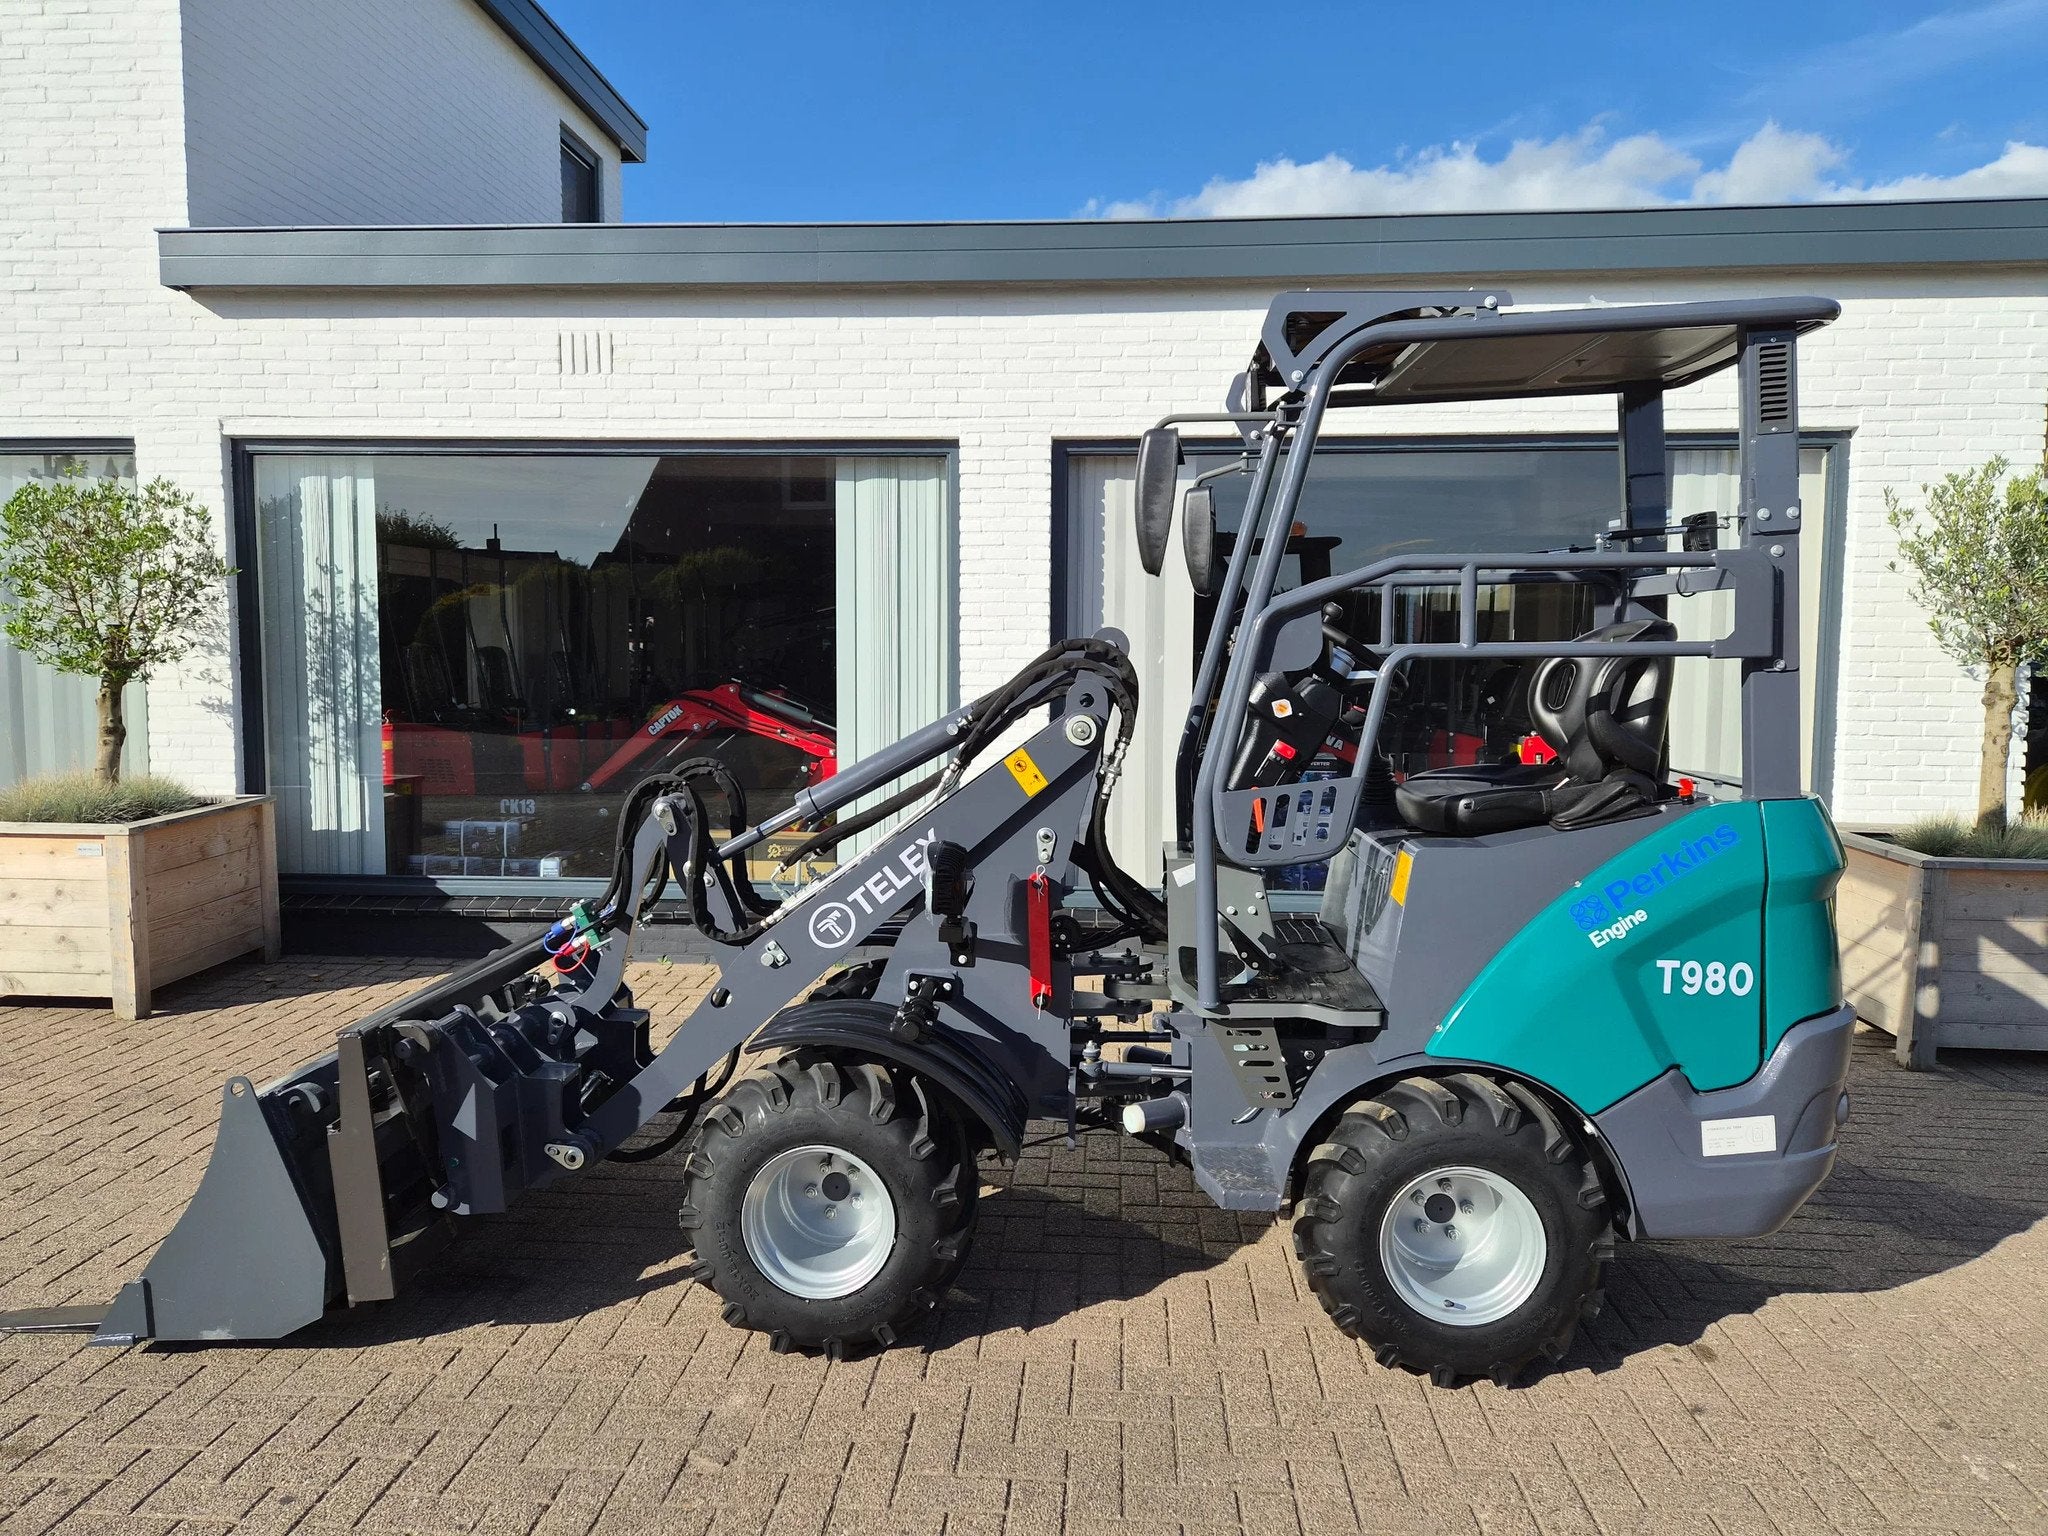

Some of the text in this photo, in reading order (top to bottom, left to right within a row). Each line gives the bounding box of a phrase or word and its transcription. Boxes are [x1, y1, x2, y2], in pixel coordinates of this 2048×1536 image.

[647, 704, 684, 736] CAPTOK
[1603, 823, 1740, 912] Perkins
[1587, 908, 1648, 949] Engine
[1656, 959, 1754, 997] T980
